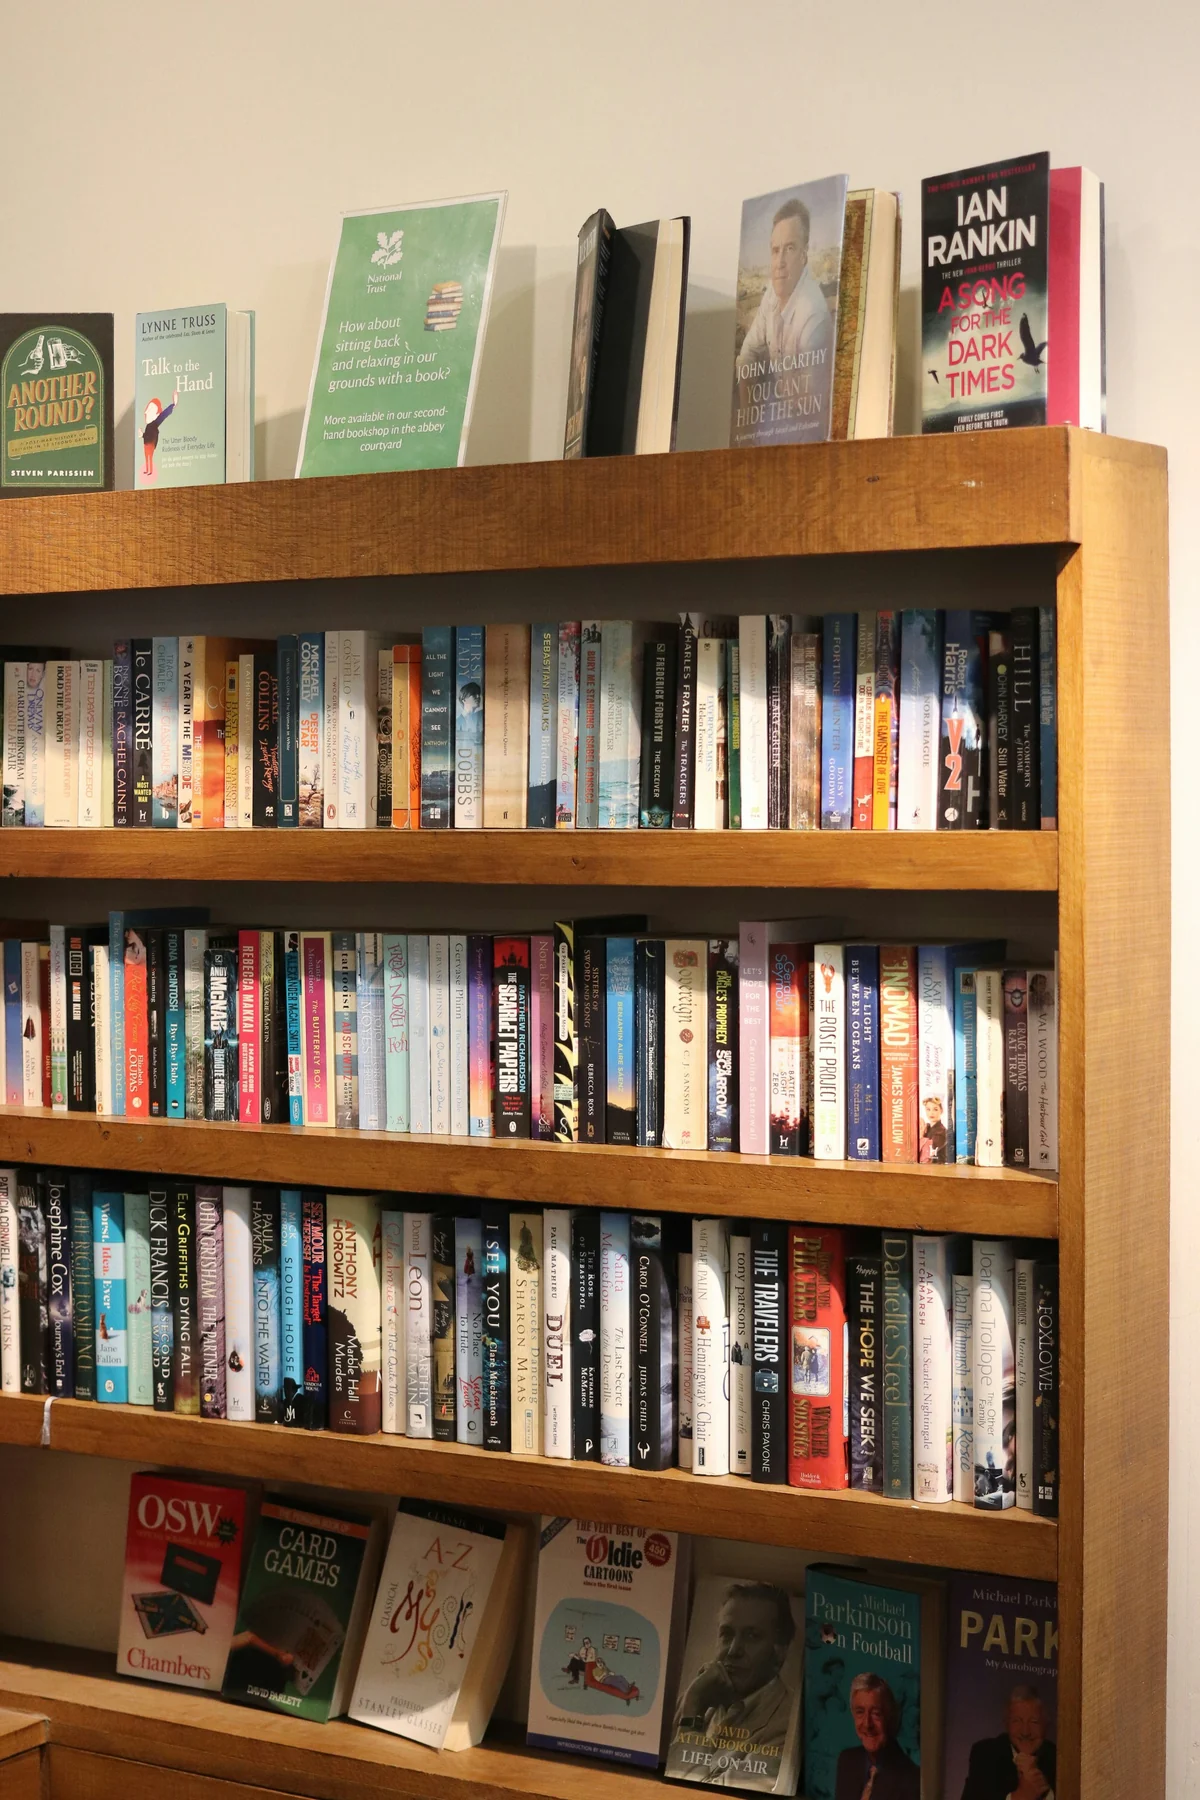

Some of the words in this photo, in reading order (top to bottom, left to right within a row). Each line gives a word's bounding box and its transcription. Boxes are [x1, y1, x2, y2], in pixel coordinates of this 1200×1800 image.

[958, 187, 1007, 226] IAN
[928, 215, 1036, 267] RANKIN
[367, 284, 386, 293] Trust
[368, 272, 402, 283] National
[938, 288, 955, 313] A
[958, 272, 1025, 303] SONG
[142, 318, 177, 334] LYNNE
[182, 314, 215, 329] TRUSS
[339, 321, 365, 333] How
[368, 318, 401, 330] about
[950, 313, 980, 334] FOR
[983, 307, 1011, 326] THE
[332, 358, 353, 370] and
[356, 354, 400, 370] relaxing
[404, 354, 414, 365] in
[417, 351, 437, 363] our
[336, 339, 370, 352] sitting
[374, 337, 400, 349] back
[948, 332, 1013, 366] DARK
[142, 358, 170, 376] Talk
[174, 363, 182, 372] to
[185, 360, 199, 371] the
[176, 373, 213, 392] Hand
[328, 376, 375, 393] grounds
[378, 373, 403, 385] with
[405, 374, 412, 383] a
[415, 368, 451, 382] book?
[735, 360, 766, 383] JOHN
[768, 348, 827, 375] McCARTHY
[945, 364, 1015, 398] TIMES
[7, 371, 97, 408] ANOTHER
[747, 382, 771, 403] YOU
[774, 373, 810, 398] CAN'T
[14, 397, 95, 431] ROUND?
[324, 414, 346, 425] More
[348, 412, 384, 423] available
[387, 412, 394, 420] in
[397, 411, 412, 420] our
[414, 406, 448, 418] second-
[736, 405, 766, 427] HIDE
[769, 400, 793, 419] THE
[796, 394, 822, 416] SUN
[184, 436, 197, 444] Bloody
[187, 443, 206, 452] Everyday
[323, 429, 344, 440] hand
[346, 426, 389, 438] bookshop
[391, 426, 399, 434] in
[401, 424, 415, 433] the
[418, 422, 445, 434] abbey
[360, 439, 402, 451] courtyard
[136, 650, 151, 667] le
[302, 642, 310, 702] CONNELLY
[311, 645, 319, 699] MICHAEL
[684, 629, 692, 679] CHARLES
[945, 644, 958, 694] Harris
[957, 650, 967, 689] Robert
[1014, 645, 1031, 712] HILL
[136, 674, 152, 750] CARRÉ
[183, 705, 191, 715] IN
[682, 685, 690, 732] FRAZIER
[117, 712, 125, 767] RACHEL
[301, 720, 309, 747] STAR
[310, 713, 318, 754] DESERT
[182, 745, 192, 789] MERDE
[458, 749, 472, 806] DOBBS
[118, 769, 126, 812] CAINE
[243, 946, 253, 990] REBECCA
[716, 971, 727, 1001] EAGLE'S
[851, 960, 860, 1015] BETWEEN
[243, 994, 254, 1032] MAKKAI
[498, 985, 517, 1038] SCARLET
[716, 1004, 727, 1044] PROPHECY
[882, 972, 910, 1046] NOMAD
[342, 1022, 352, 1080] AUSCHWITZ
[852, 1021, 860, 1069] OCEANS
[129, 1048, 138, 1092] LOUPAS
[499, 1042, 517, 1092] PAPERS
[716, 1049, 727, 1117] SCARROW
[892, 1066, 903, 1095] JAMES
[892, 1099, 903, 1144] SWALLOW
[47, 1181, 67, 1259] Josephine
[149, 1190, 167, 1228] DICK
[199, 1197, 216, 1236] JOHN
[150, 1238, 168, 1307] FRANCIS
[200, 1237, 217, 1297] GRISHAM
[333, 1219, 344, 1298] HOROWITZ
[345, 1220, 357, 1298] ANTHONY
[486, 1240, 498, 1274] SEE
[754, 1250, 777, 1276] THE
[52, 1264, 66, 1295] Cox
[792, 1236, 821, 1321] PILCHER
[883, 1239, 907, 1338] Danielle
[979, 1250, 994, 1312] Joanna
[202, 1306, 216, 1328] THE
[487, 1283, 500, 1327] YOU
[860, 1283, 874, 1313] THE
[53, 1319, 64, 1358] Journey's
[754, 1282, 777, 1363] TRAVELERS
[202, 1330, 218, 1380] PARTNER
[489, 1342, 498, 1366] Clare
[860, 1319, 874, 1367] HOPE
[977, 1319, 996, 1386] Trollope
[1038, 1305, 1052, 1390] FOXLOWE
[55, 1360, 64, 1377] End
[884, 1344, 908, 1406] Steel
[489, 1370, 499, 1426] Mackintosh
[861, 1374, 873, 1402] WE
[762, 1400, 770, 1428] CHRIS
[861, 1407, 874, 1446] SEEK
[137, 1495, 222, 1536] OSW
[576, 1521, 591, 1531] THE
[594, 1522, 613, 1533] VERY
[615, 1523, 635, 1536] BEST
[637, 1526, 647, 1537] OF
[279, 1527, 337, 1559] CARD
[576, 1536, 586, 1545] The
[265, 1549, 340, 1587] GAMES
[584, 1565, 633, 1584] CARTOONS
[812, 1592, 912, 1639] Parkinson
[863, 1595, 905, 1616] Michael
[852, 1631, 912, 1664] Football
[960, 1610, 1058, 1660] PARK
[127, 1647, 210, 1681] Chambers
[247, 1685, 268, 1698] DAVID
[268, 1691, 302, 1708] PARLETT
[676, 1731, 780, 1757] ATTENBOROUGH
[714, 1724, 750, 1739] DAVID
[682, 1750, 711, 1766] LIFE
[718, 1756, 740, 1770] ON
[744, 1759, 767, 1774] AIR
